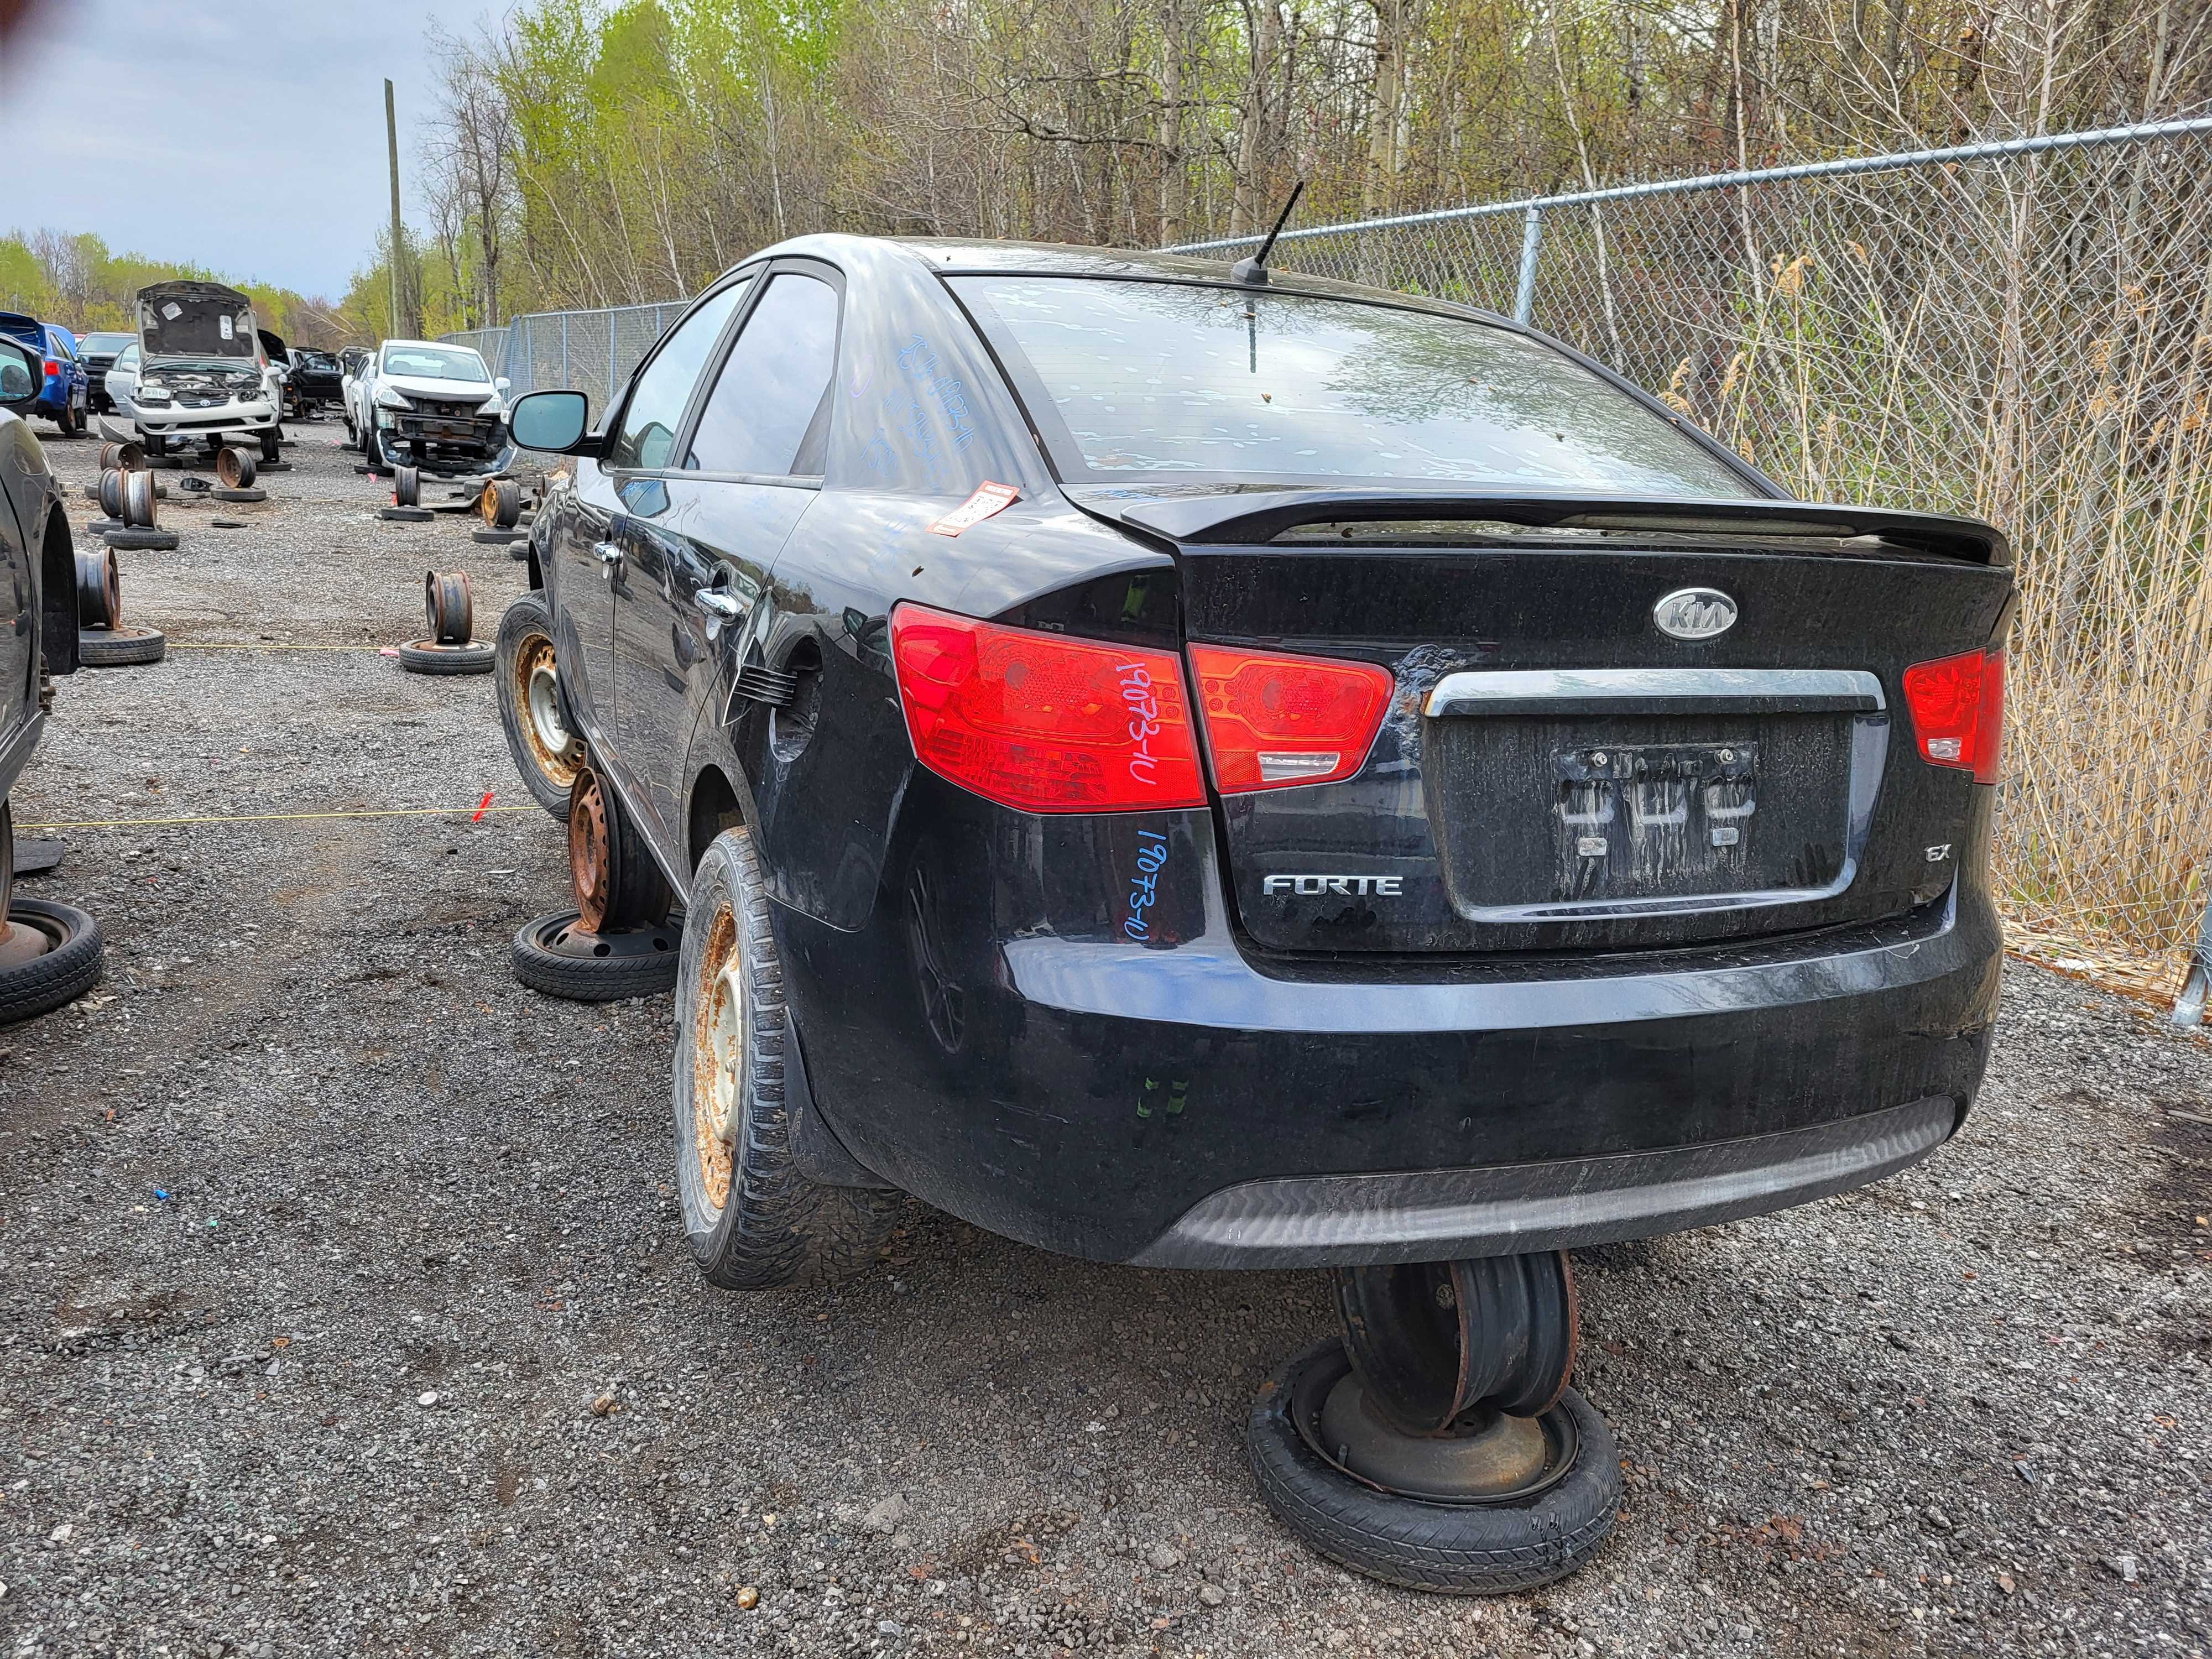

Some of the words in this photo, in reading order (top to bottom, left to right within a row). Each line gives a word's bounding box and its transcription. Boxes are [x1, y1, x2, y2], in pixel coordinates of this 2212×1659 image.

[1669, 602, 1722, 628] KIA
[1925, 844, 1952, 862] EX
[1263, 875, 1404, 895] FORTE
